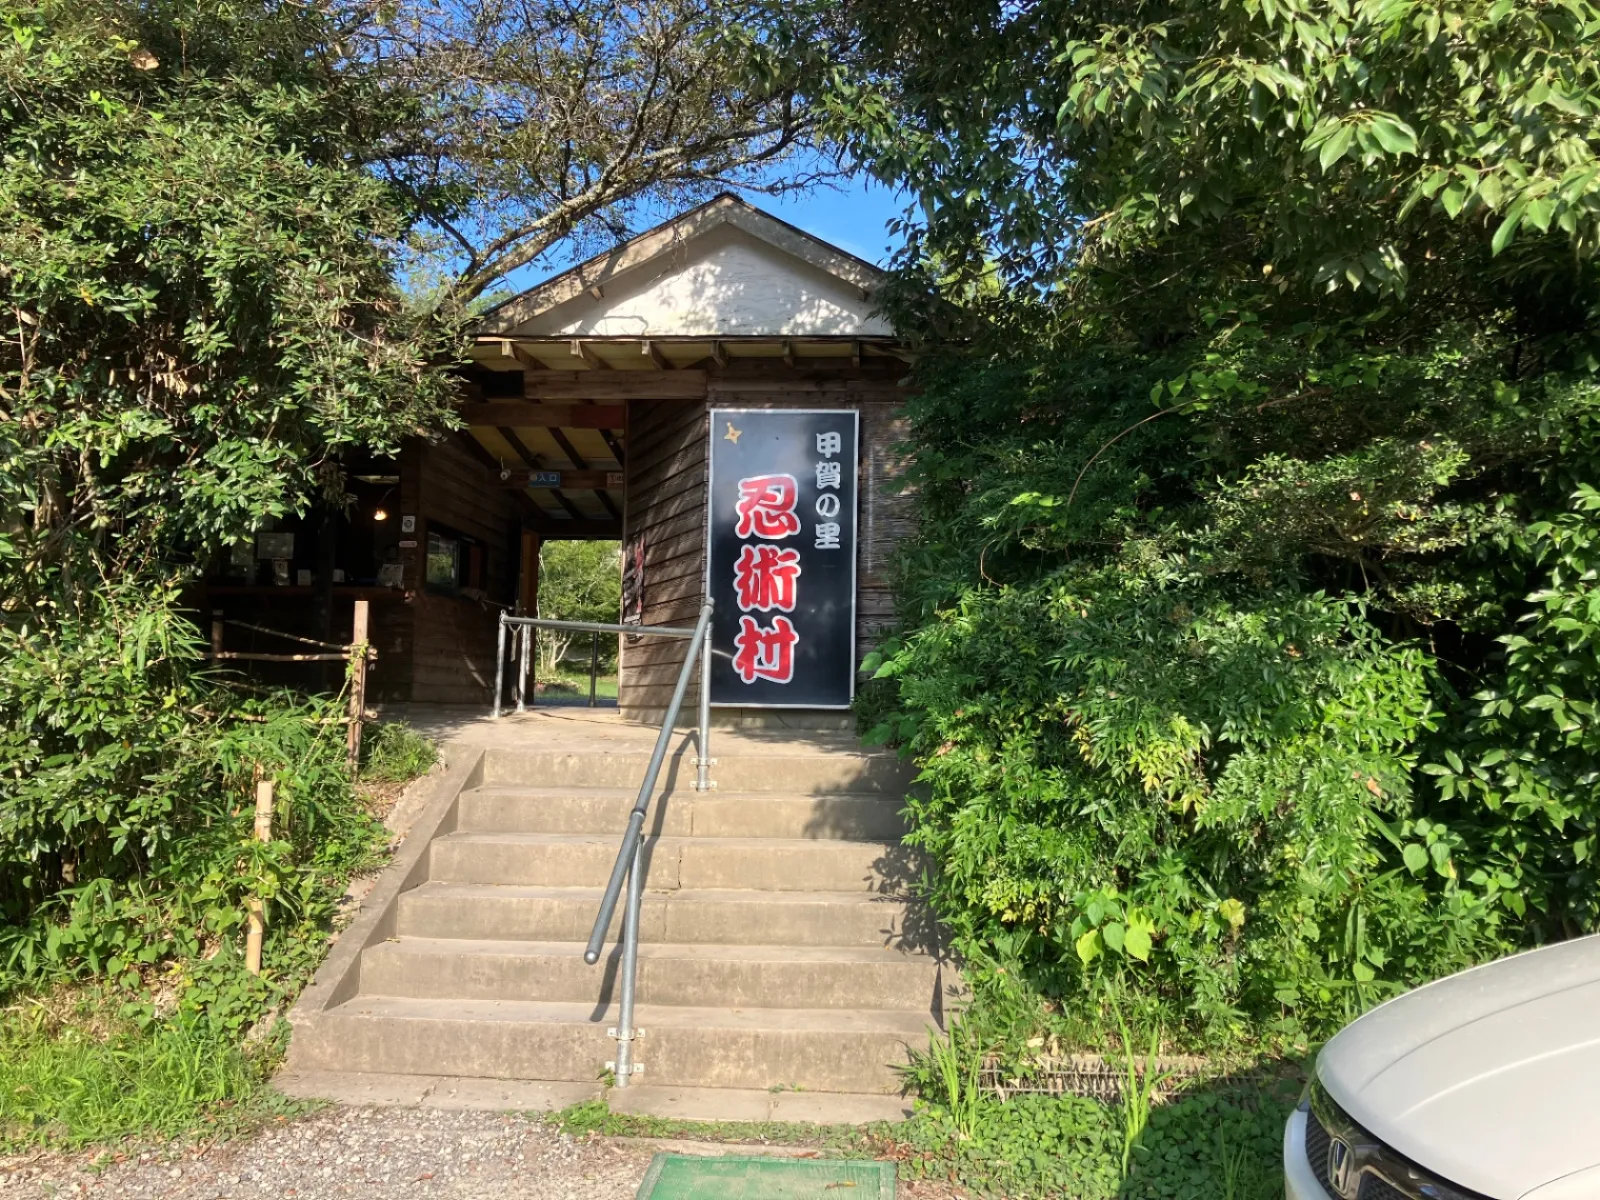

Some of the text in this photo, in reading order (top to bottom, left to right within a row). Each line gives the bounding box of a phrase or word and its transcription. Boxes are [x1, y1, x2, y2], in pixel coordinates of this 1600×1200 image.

[538, 473, 557, 482] 入口
[814, 431, 841, 549] 甲賀の里
[732, 473, 801, 684] 忍術村
